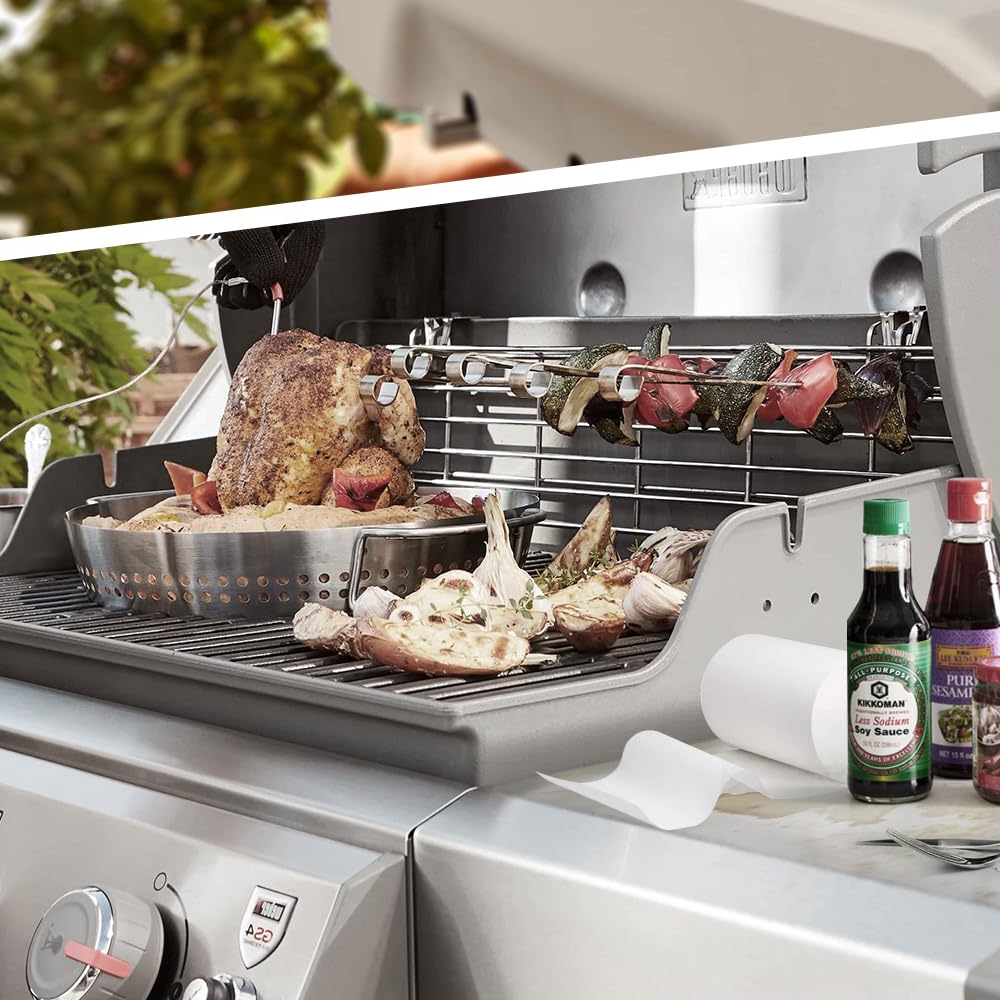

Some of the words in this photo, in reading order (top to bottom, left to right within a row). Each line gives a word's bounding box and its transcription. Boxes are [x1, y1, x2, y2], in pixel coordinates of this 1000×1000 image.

[947, 674, 977, 686] PUR
[857, 699, 905, 708] KIKKOMAN
[854, 714, 871, 726] Less
[873, 716, 910, 727] Sodium
[854, 725, 872, 737] Soy
[874, 727, 910, 736] Sauce
